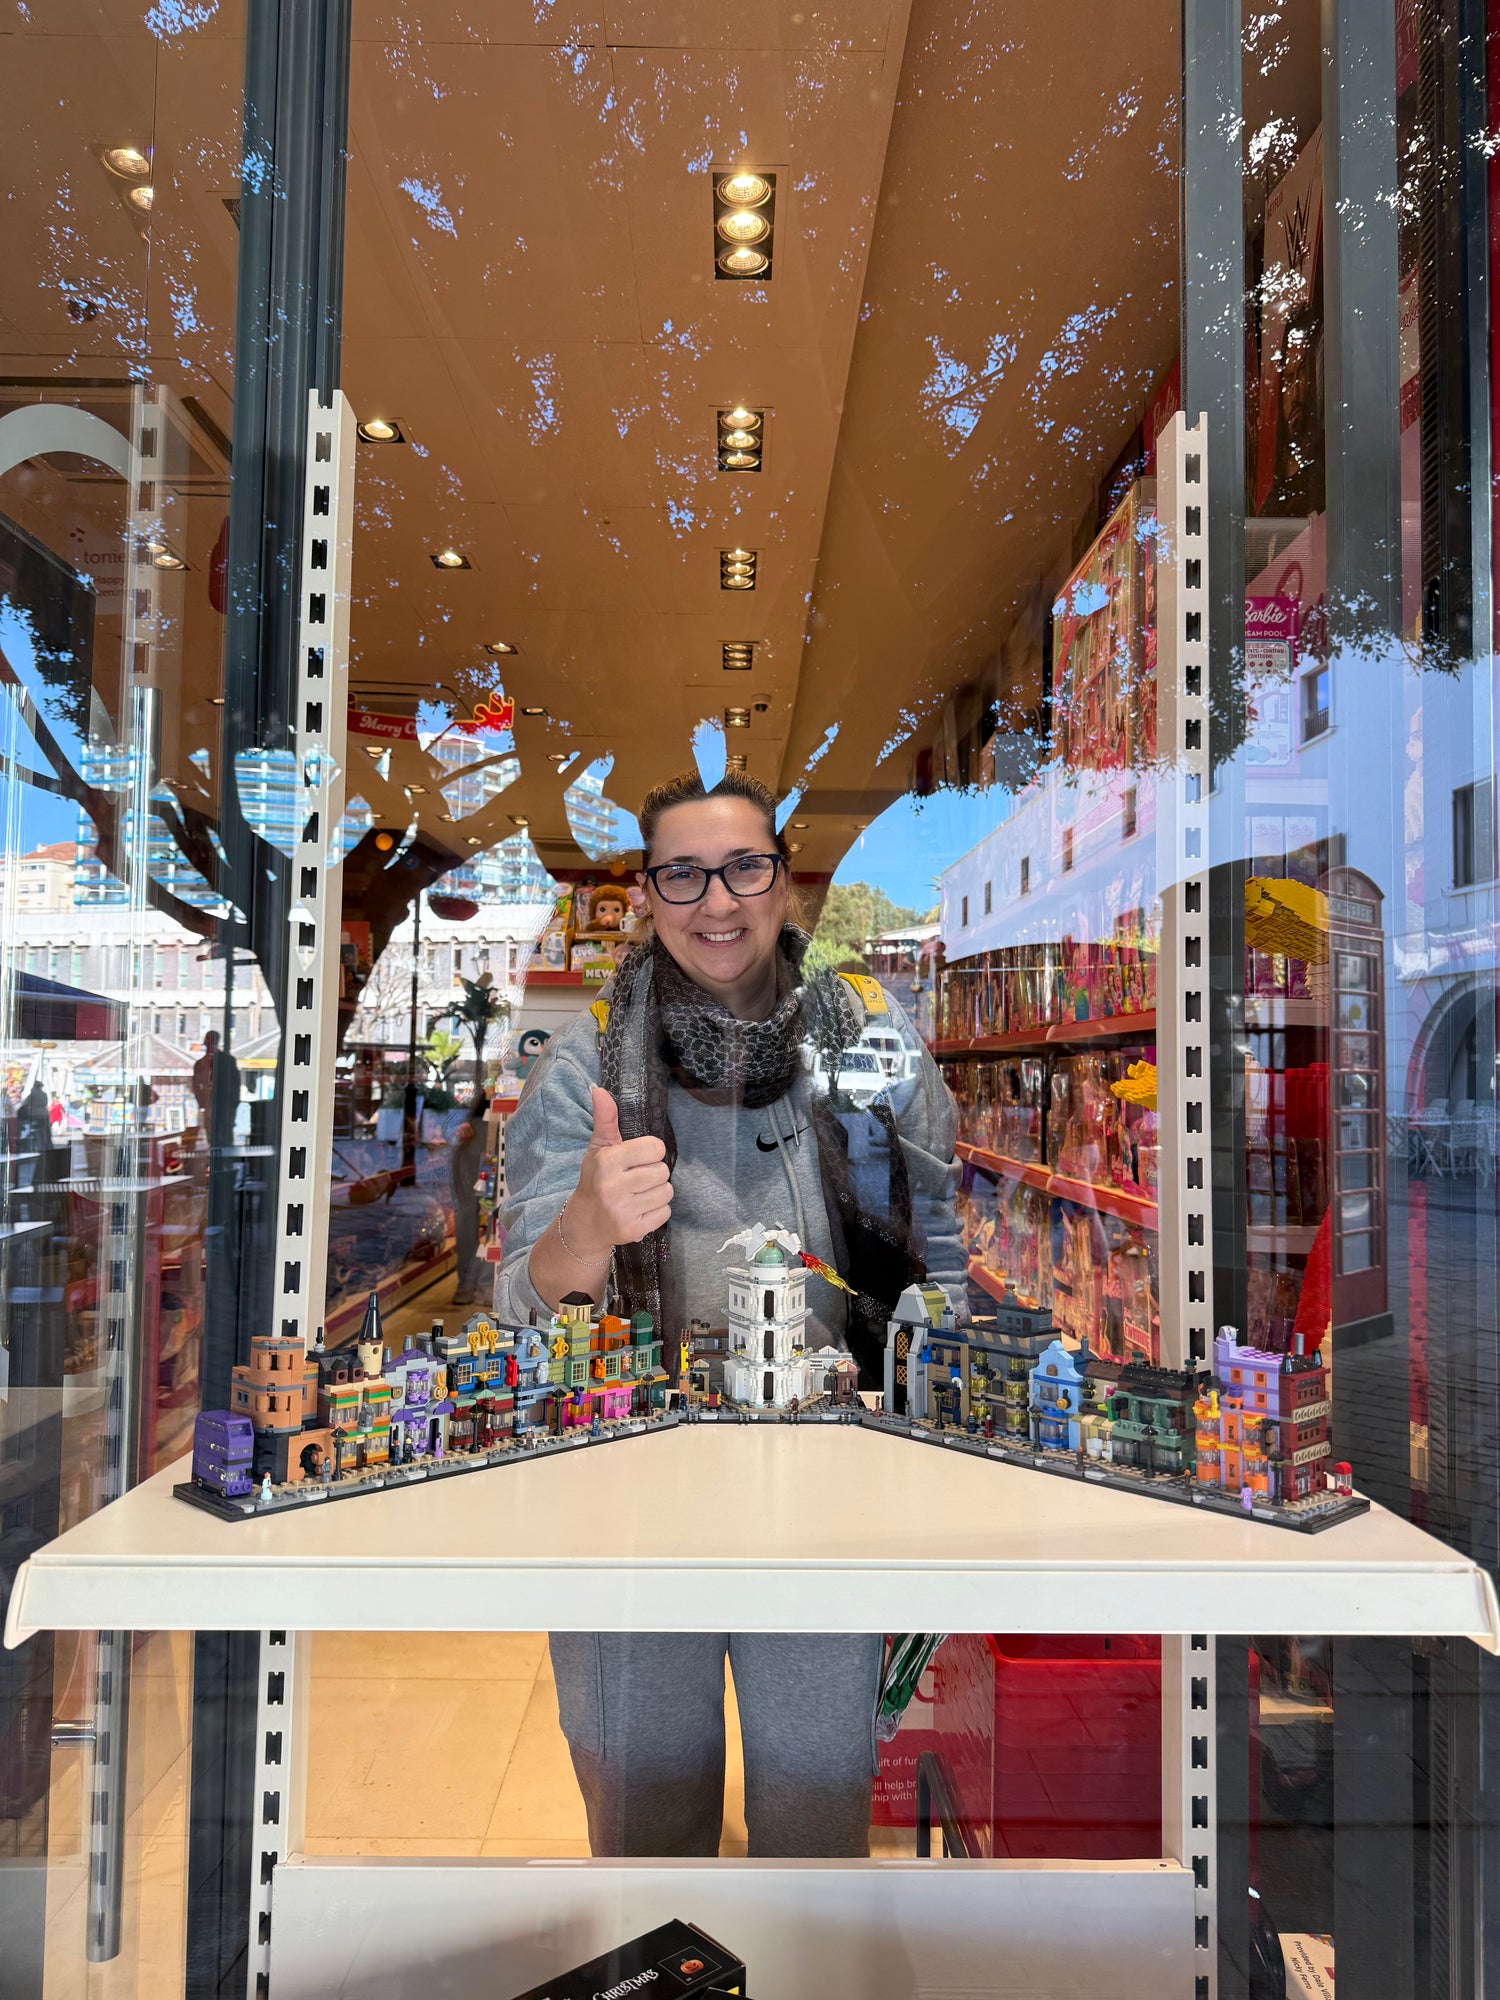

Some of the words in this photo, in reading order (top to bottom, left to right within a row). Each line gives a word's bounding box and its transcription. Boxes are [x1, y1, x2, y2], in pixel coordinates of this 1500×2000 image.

[84, 549, 126, 564] tonie
[1263, 629, 1285, 637] POOL
[359, 714, 403, 737] Merry
[573, 947, 595, 957] Live
[585, 968, 614, 979] NEW
[878, 1756, 891, 1768] ift
[892, 1756, 902, 1767] of
[871, 1780, 883, 1791] ill
[884, 1780, 905, 1791] help
[906, 1779, 918, 1789] br
[891, 1790, 913, 1801] with
[1294, 1941, 1314, 1966] Provided
[1290, 1957, 1303, 1973] Nicky
